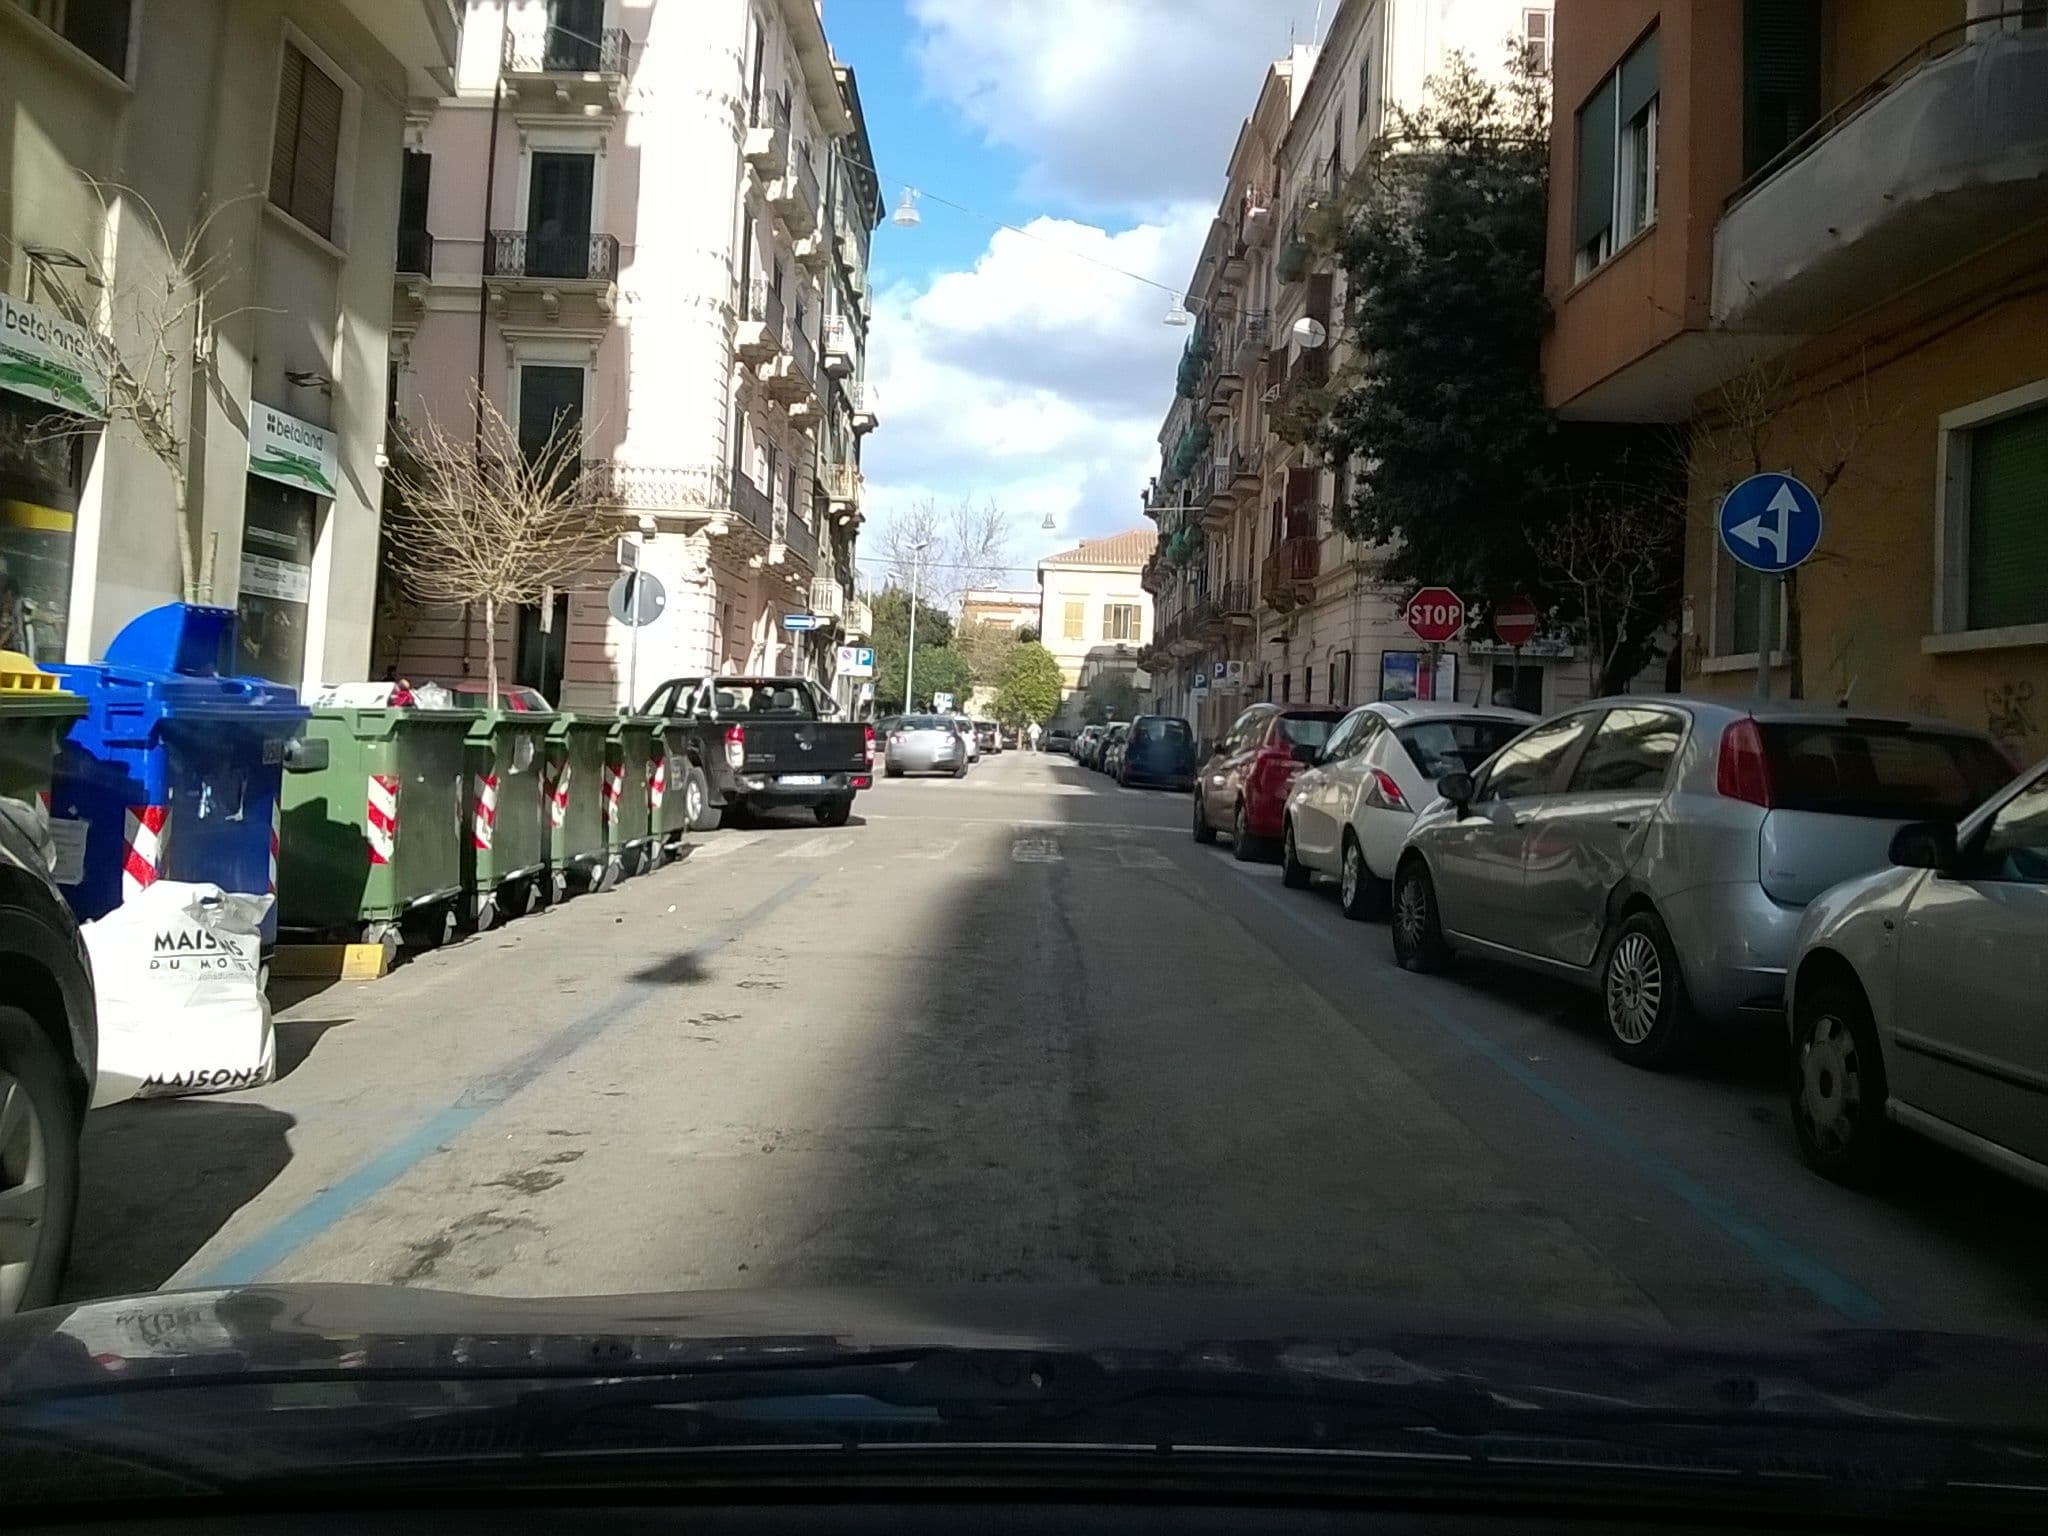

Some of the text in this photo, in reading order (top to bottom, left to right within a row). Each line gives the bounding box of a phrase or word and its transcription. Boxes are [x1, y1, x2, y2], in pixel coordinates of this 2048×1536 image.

[276, 416, 324, 452] betaland
[1410, 604, 1460, 625] STOP
[858, 650, 870, 665] P
[1214, 662, 1224, 678] P
[1195, 674, 1206, 687] P
[149, 959, 181, 970] DU
[139, 1065, 264, 1089] MAISONS
